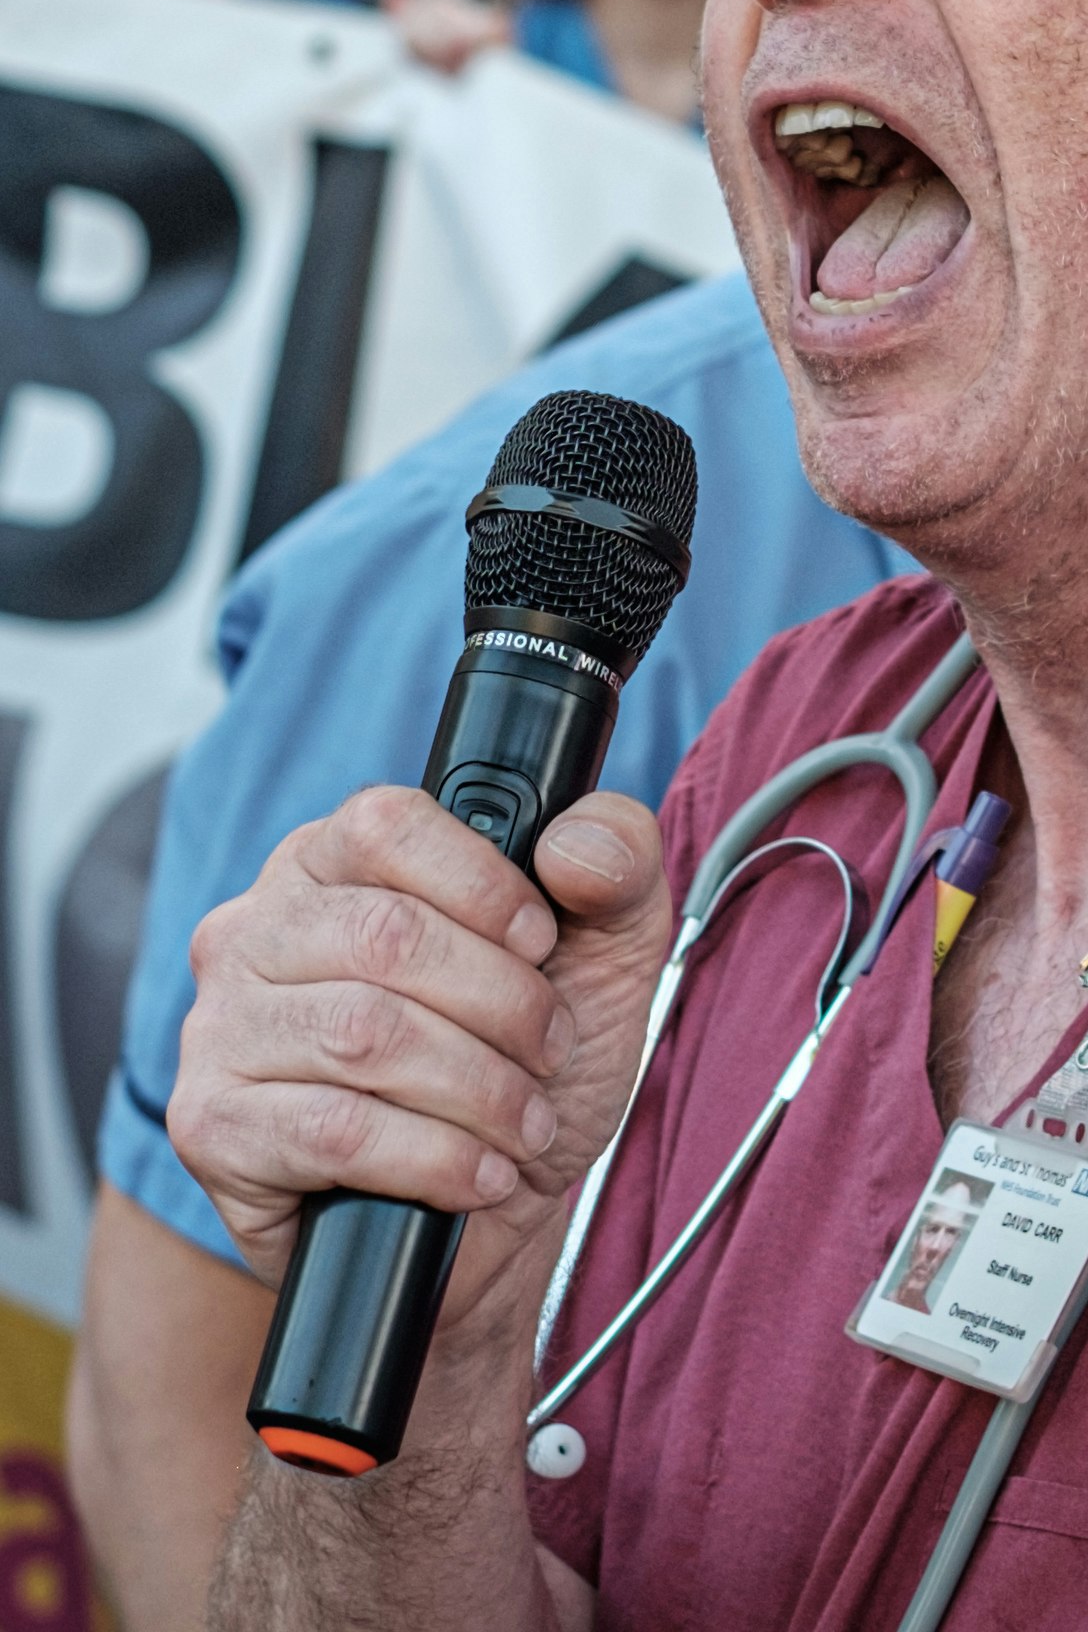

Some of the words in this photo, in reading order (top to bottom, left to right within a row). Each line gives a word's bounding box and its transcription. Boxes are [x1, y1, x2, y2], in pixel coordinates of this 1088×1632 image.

[574, 653, 622, 691] WIREL
[1000, 1155, 1020, 1172] and
[1001, 1212, 1034, 1234] DAVID
[1033, 1222, 1064, 1244] CARR
[987, 1259, 1010, 1278] Staff
[1007, 1266, 1033, 1286] Nurse
[949, 1302, 990, 1328] Overnight
[989, 1317, 1026, 1340] Intensive
[960, 1325, 1000, 1353] Recovery
